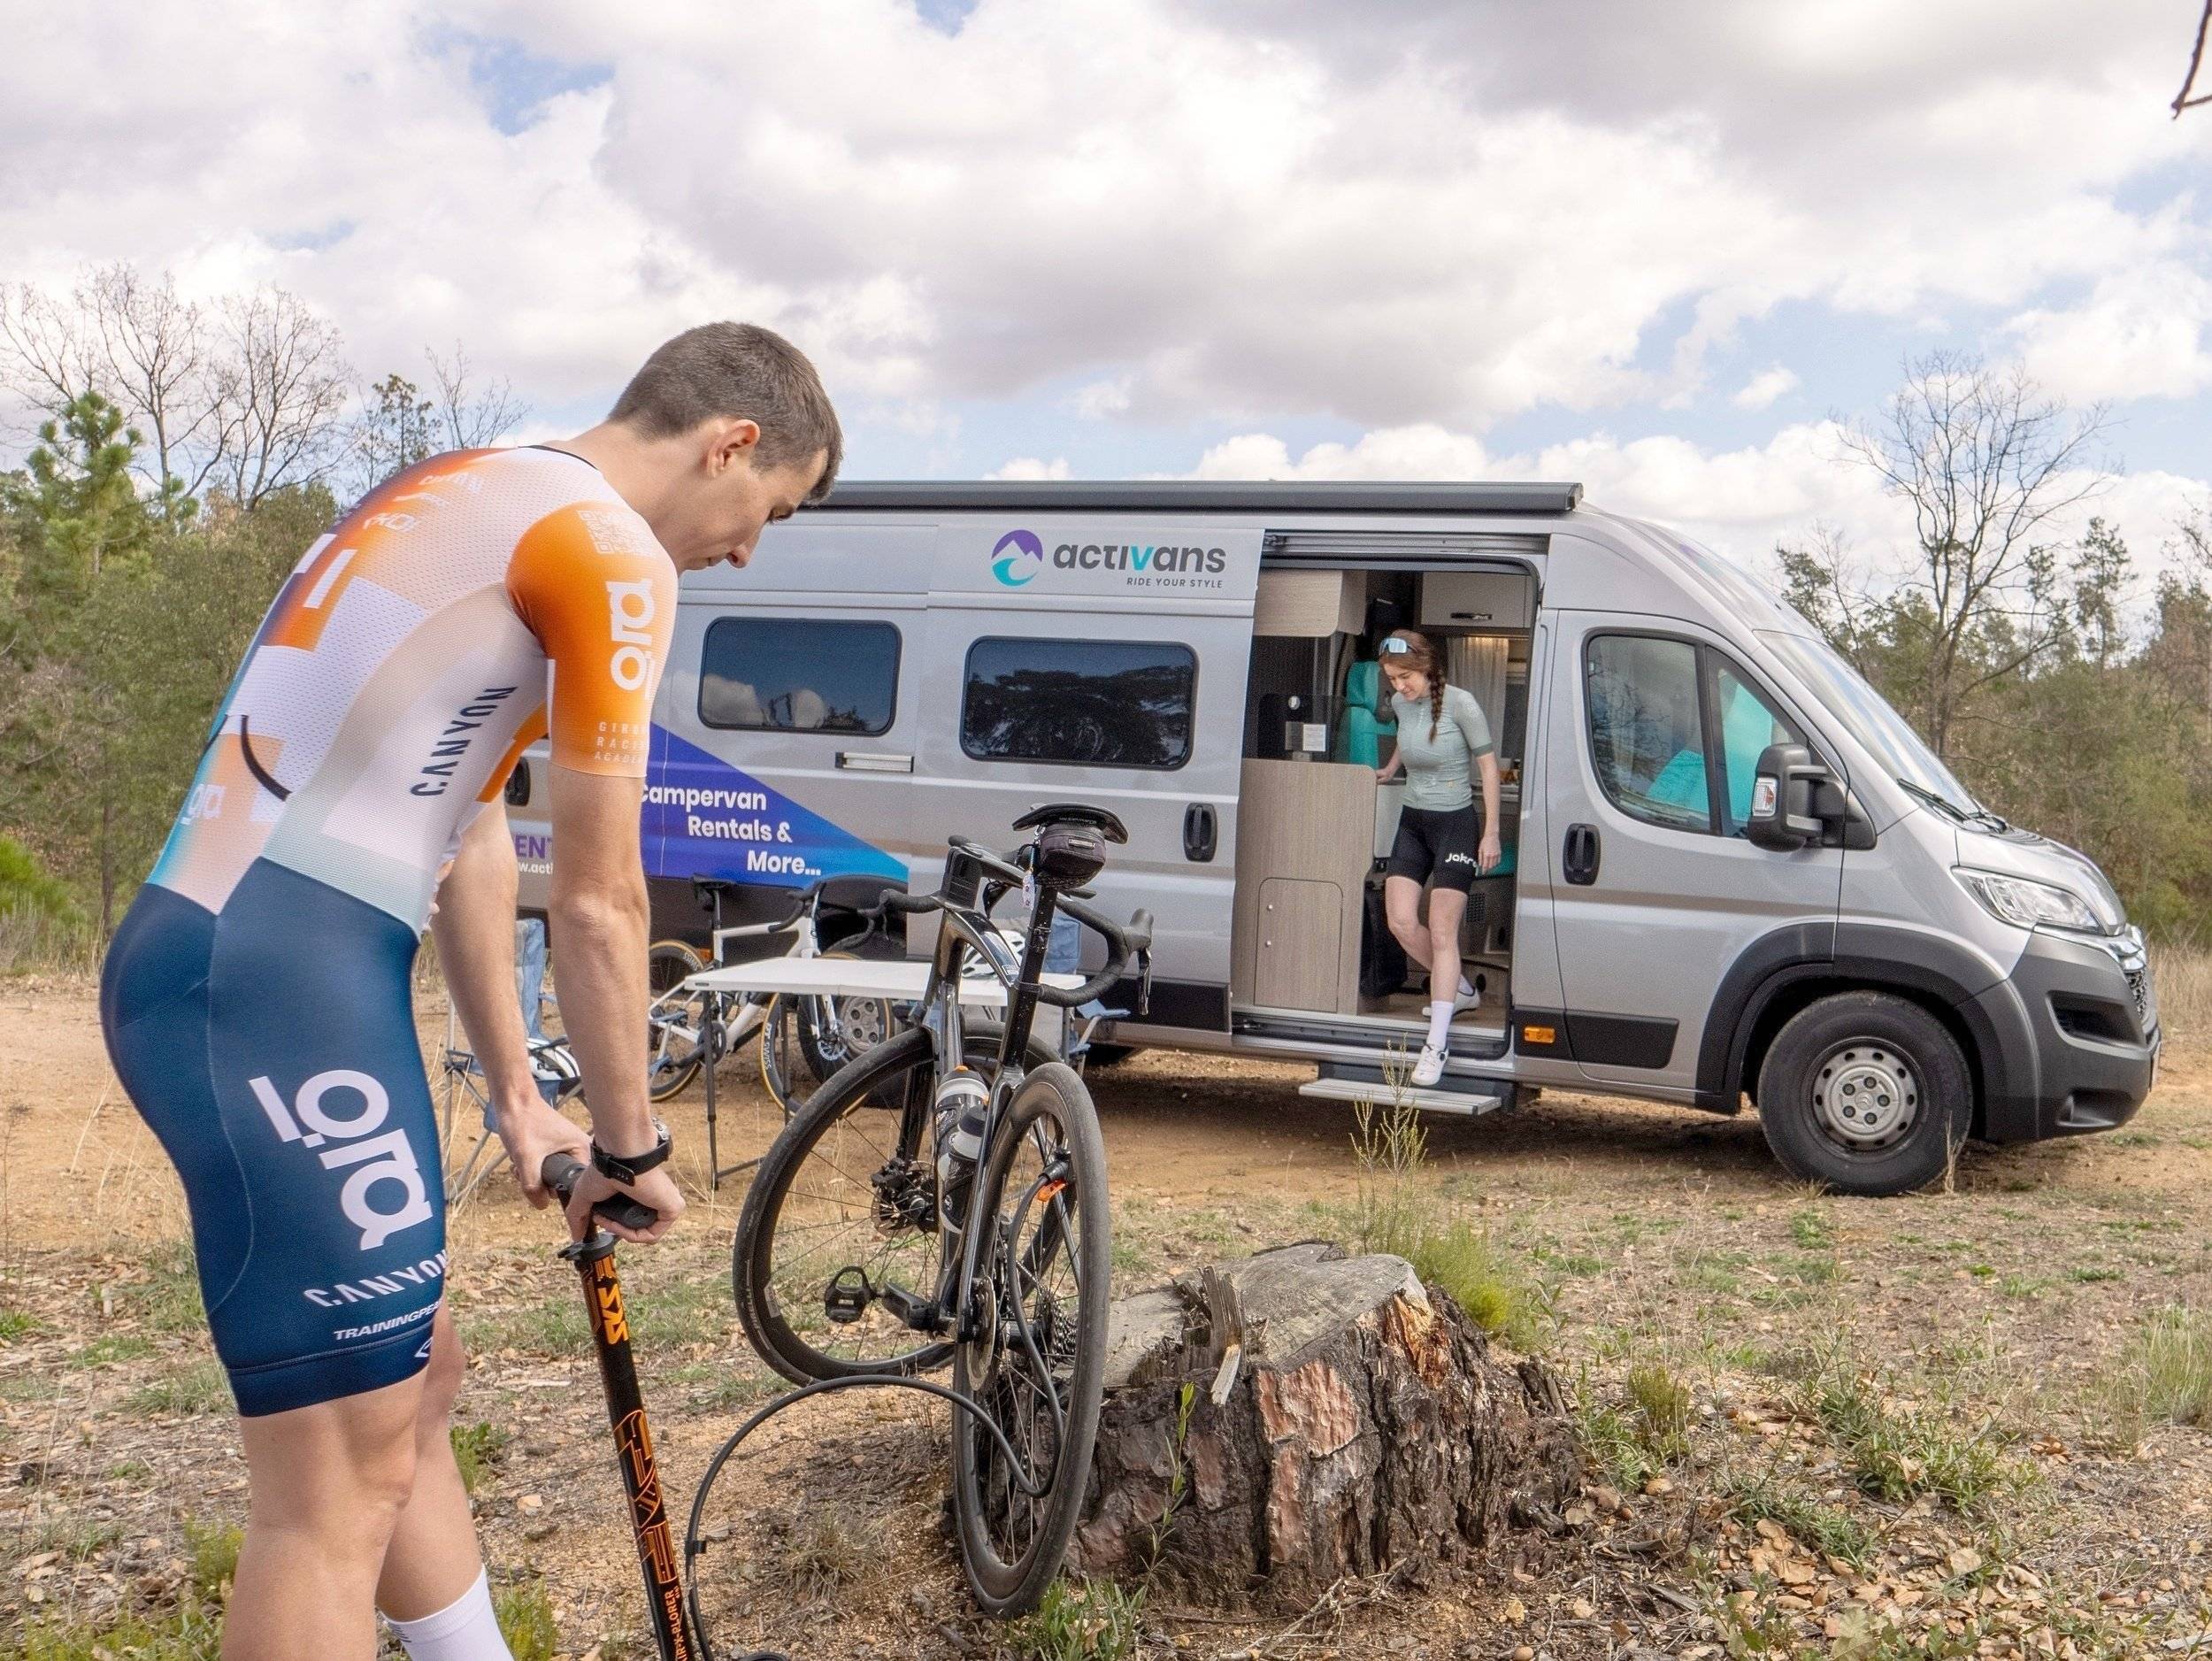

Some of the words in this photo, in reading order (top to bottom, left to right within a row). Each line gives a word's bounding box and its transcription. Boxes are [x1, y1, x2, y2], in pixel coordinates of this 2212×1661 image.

[1053, 543, 1226, 573] activans
[1126, 577, 1151, 586] RIDE
[1156, 578, 1186, 587] YOUR
[411, 687, 518, 796] CANYON
[687, 815, 772, 842] Rentals
[776, 821, 793, 842] &
[747, 850, 821, 875] More...
[597, 1283, 629, 1344] SKS
